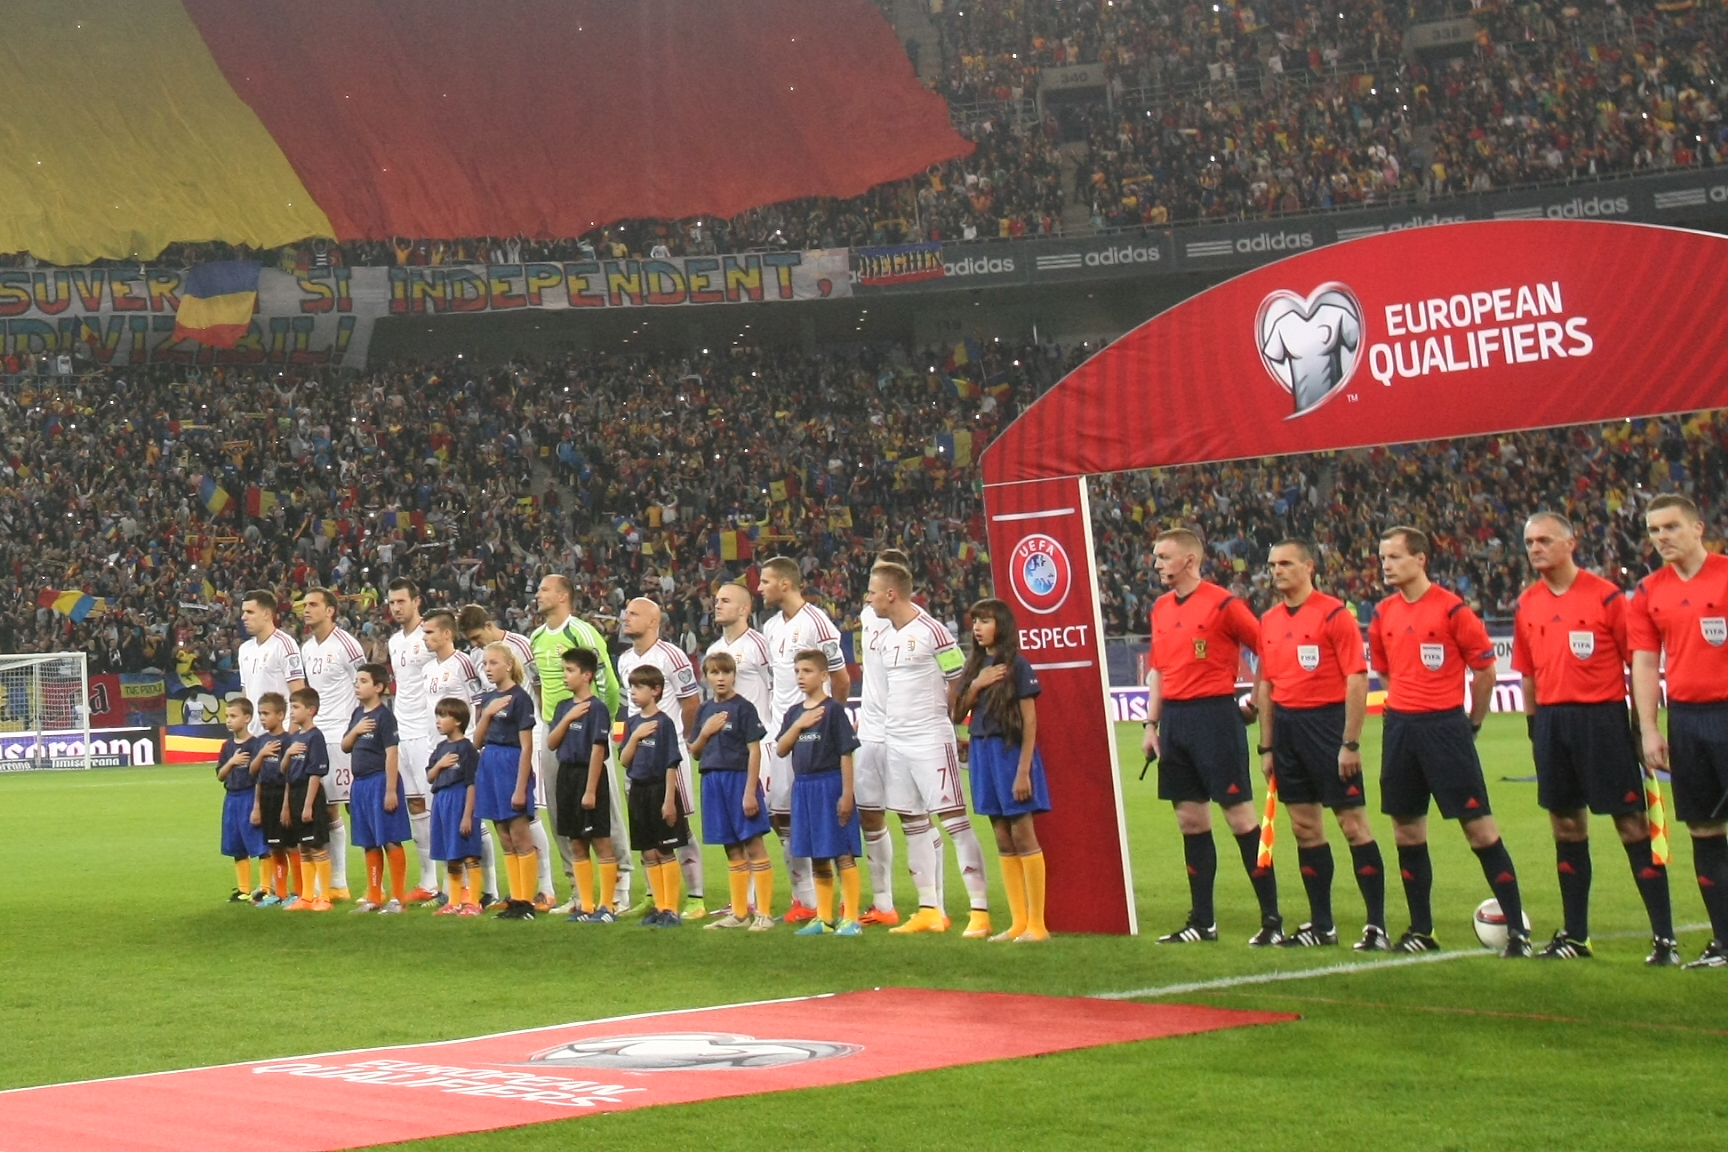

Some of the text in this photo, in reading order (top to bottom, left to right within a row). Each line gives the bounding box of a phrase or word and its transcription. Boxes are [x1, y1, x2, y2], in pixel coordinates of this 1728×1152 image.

[1546, 195, 1630, 220] adidas
[1237, 231, 1314, 253] adidas
[944, 256, 1015, 276] adidas
[1085, 244, 1161, 266] adidas
[1384, 281, 1563, 337] EUROPEAN
[1369, 317, 1594, 387] QUALIFIERS
[1018, 540, 1056, 558] UEFA
[1018, 624, 1088, 650] ESPECT
[312, 657, 323, 675] 23
[400, 650, 407, 667] 6
[894, 646, 900, 668] 7
[335, 768, 351, 786] 23
[937, 767, 947, 790] 7
[252, 1062, 622, 1107] QUALIFIERS
[345, 1059, 648, 1097] EUROPEAN
